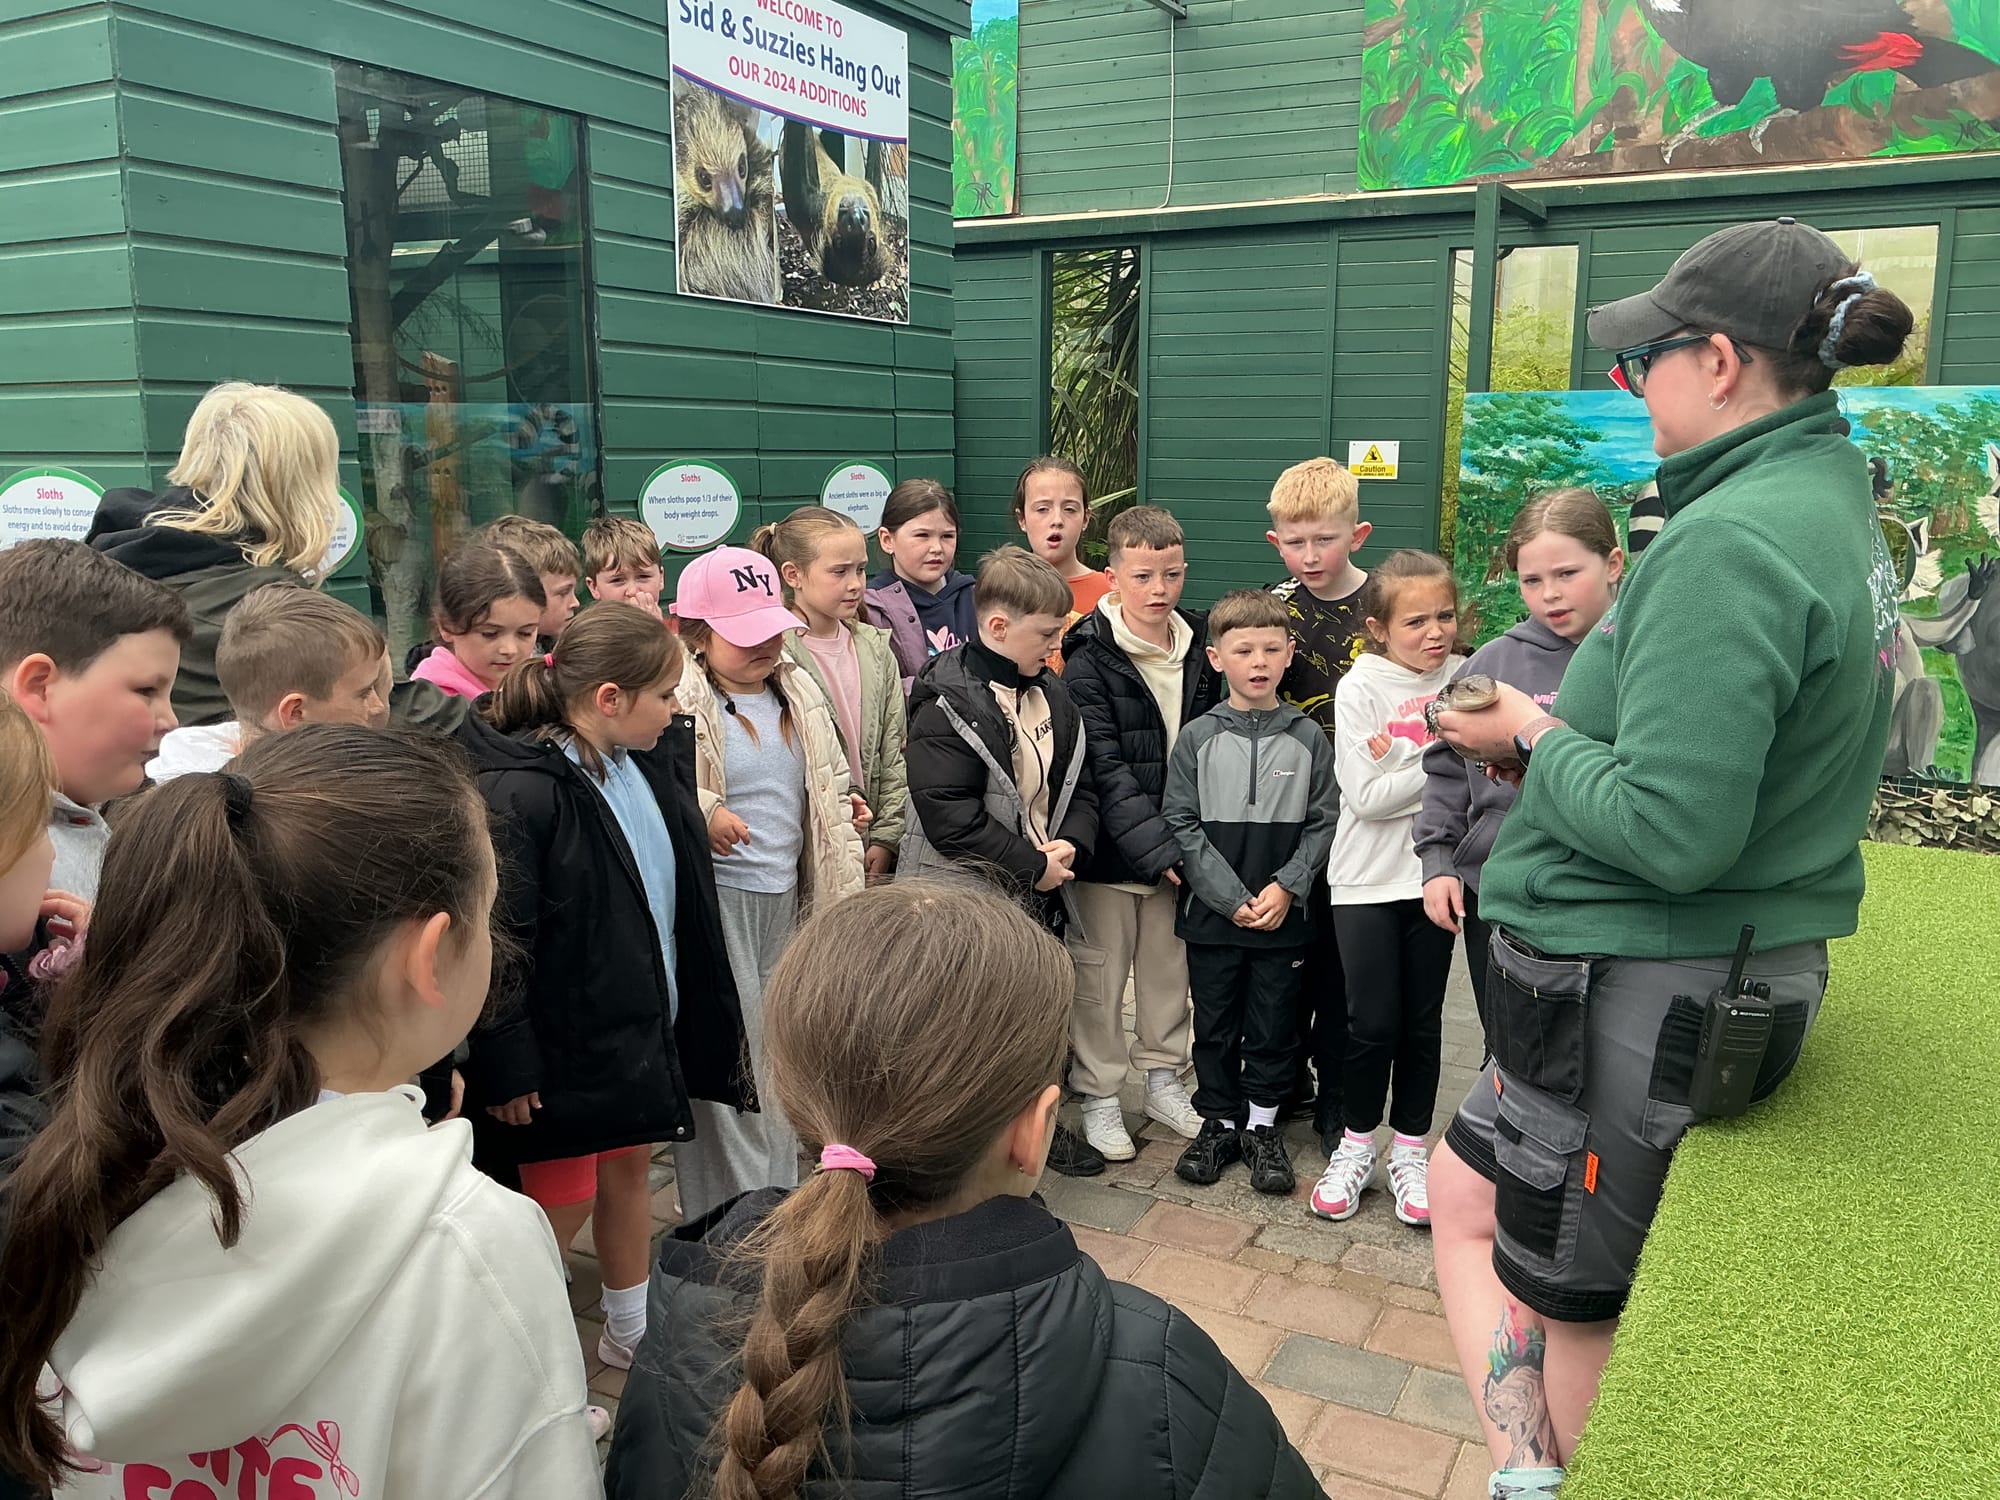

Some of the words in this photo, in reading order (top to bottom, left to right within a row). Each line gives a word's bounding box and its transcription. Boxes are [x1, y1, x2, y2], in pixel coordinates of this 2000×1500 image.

[757, 0, 822, 31] WELCOME
[825, 16, 842, 38] TO
[680, 0, 713, 32] Sid
[721, 8, 736, 40] &
[743, 16, 815, 67] Suzzies
[821, 44, 866, 92] Hang
[872, 64, 901, 98] Out
[729, 56, 760, 82] OUR
[764, 67, 796, 94] 2024
[800, 80, 867, 117] ADDITIONS
[1360, 465, 1386, 473] Caution
[681, 474, 701, 482] Sloths
[850, 472, 865, 480] Sloths
[36, 488, 64, 500] Sloths
[648, 495, 666, 504] When
[667, 495, 685, 504] sloths
[702, 494, 711, 502] 1/3
[712, 494, 718, 502] of
[719, 493, 732, 502] their
[829, 491, 845, 499] Ancient
[846, 490, 858, 498] sloths
[2, 504, 22, 514] Sloths
[23, 507, 41, 515] move
[42, 506, 62, 518] slowly
[64, 508, 71, 516] to
[72, 509, 96, 517] conser
[664, 510, 679, 520] body
[681, 510, 700, 520] weight
[701, 510, 719, 519] drops.
[8, 522, 29, 533] energy
[31, 521, 43, 530] and
[44, 522, 51, 530] to
[53, 523, 70, 531] avoid
[72, 523, 89, 532] draw
[729, 565, 774, 596] NY
